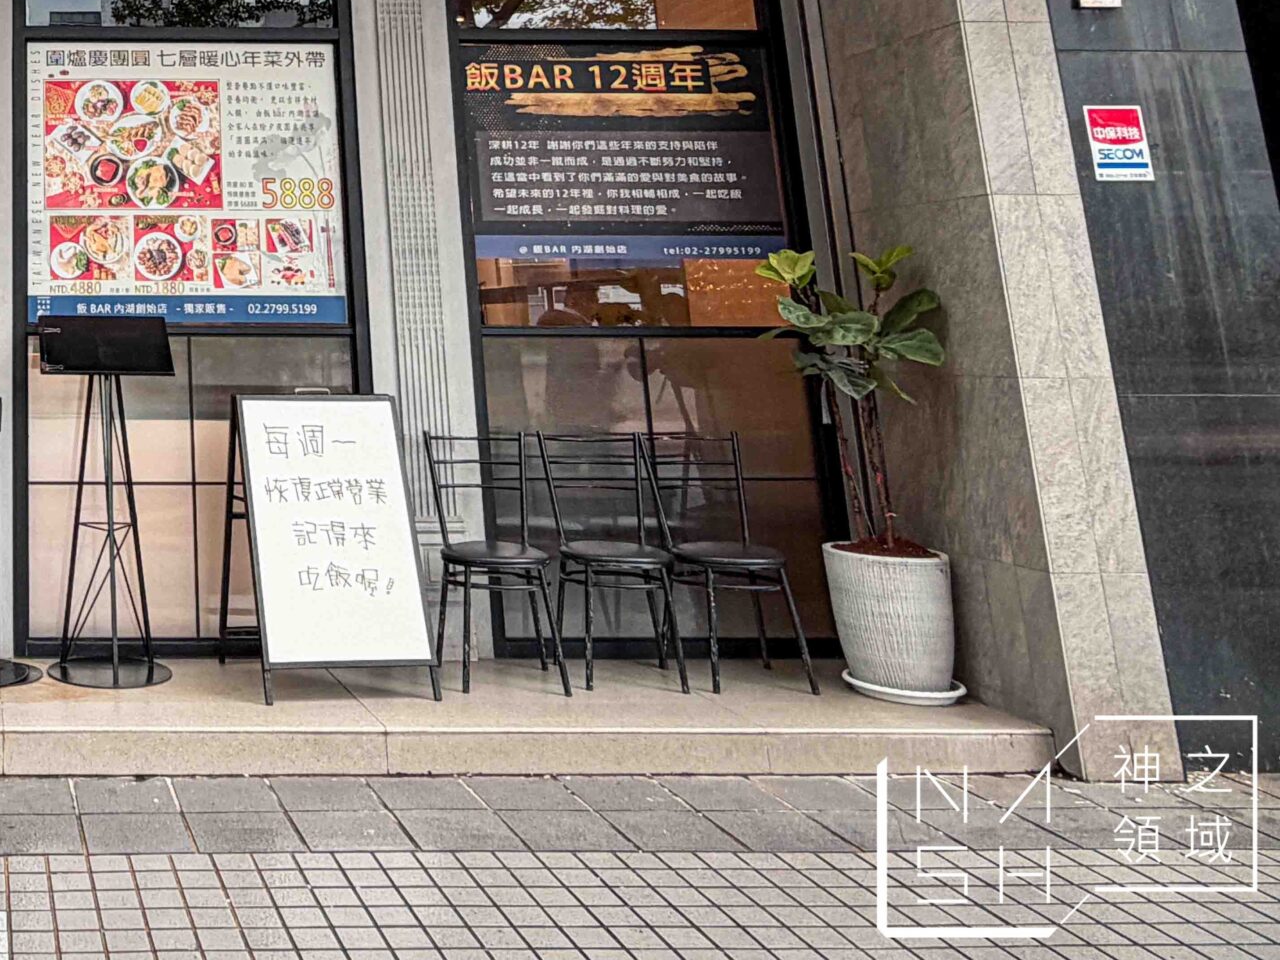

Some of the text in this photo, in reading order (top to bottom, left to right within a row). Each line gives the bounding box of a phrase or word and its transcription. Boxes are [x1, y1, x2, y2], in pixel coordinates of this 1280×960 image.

[46, 49, 327, 68] 圍爐慶團圓 七層暖心年菜外帶
[30, 49, 41, 101] DISHES
[464, 62, 705, 92] 飯BAR 12週年
[31, 113, 41, 148] YEAR
[1097, 148, 1145, 160] SECOM
[261, 177, 335, 210] 5888
[663, 246, 762, 256] tel:02-27995199
[90, 303, 111, 314] BAR
[247, 303, 318, 315] 02.2799.5199
[263, 422, 357, 459] 每週一
[264, 476, 388, 505] 恢復正常營業
[292, 520, 377, 550] 記得來
